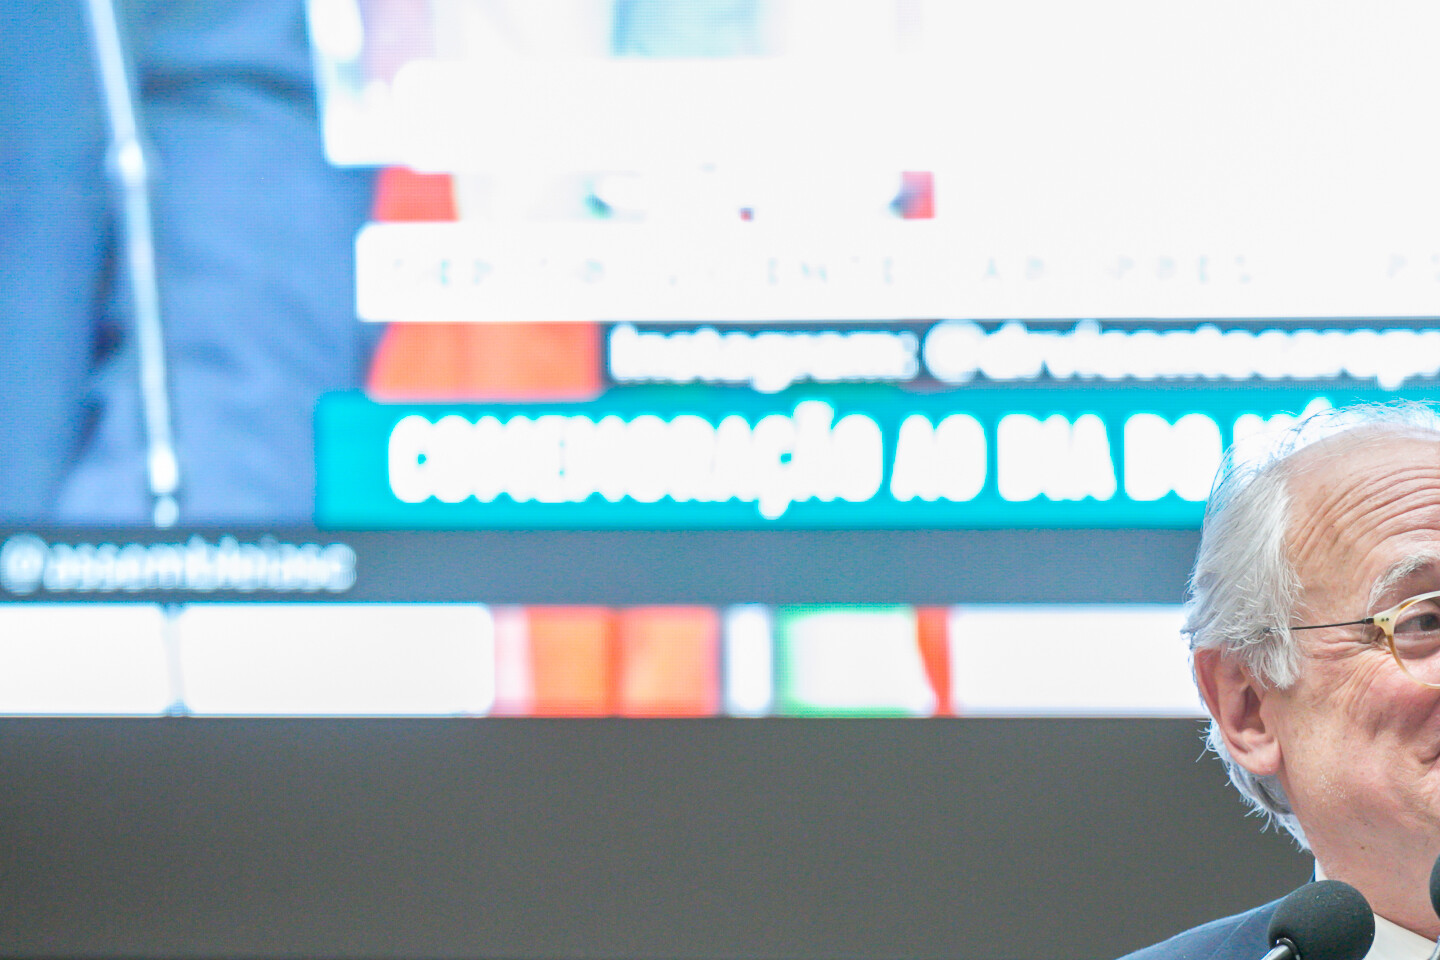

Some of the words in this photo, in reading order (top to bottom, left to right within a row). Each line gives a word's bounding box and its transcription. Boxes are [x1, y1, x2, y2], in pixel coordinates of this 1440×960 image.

[388, 400, 884, 519] COMEMORAÇÃO
[890, 413, 988, 502] AO
[997, 413, 1118, 502] DIA
[1124, 413, 1222, 502] DO
[1, 533, 357, 594] @assembleiasc
